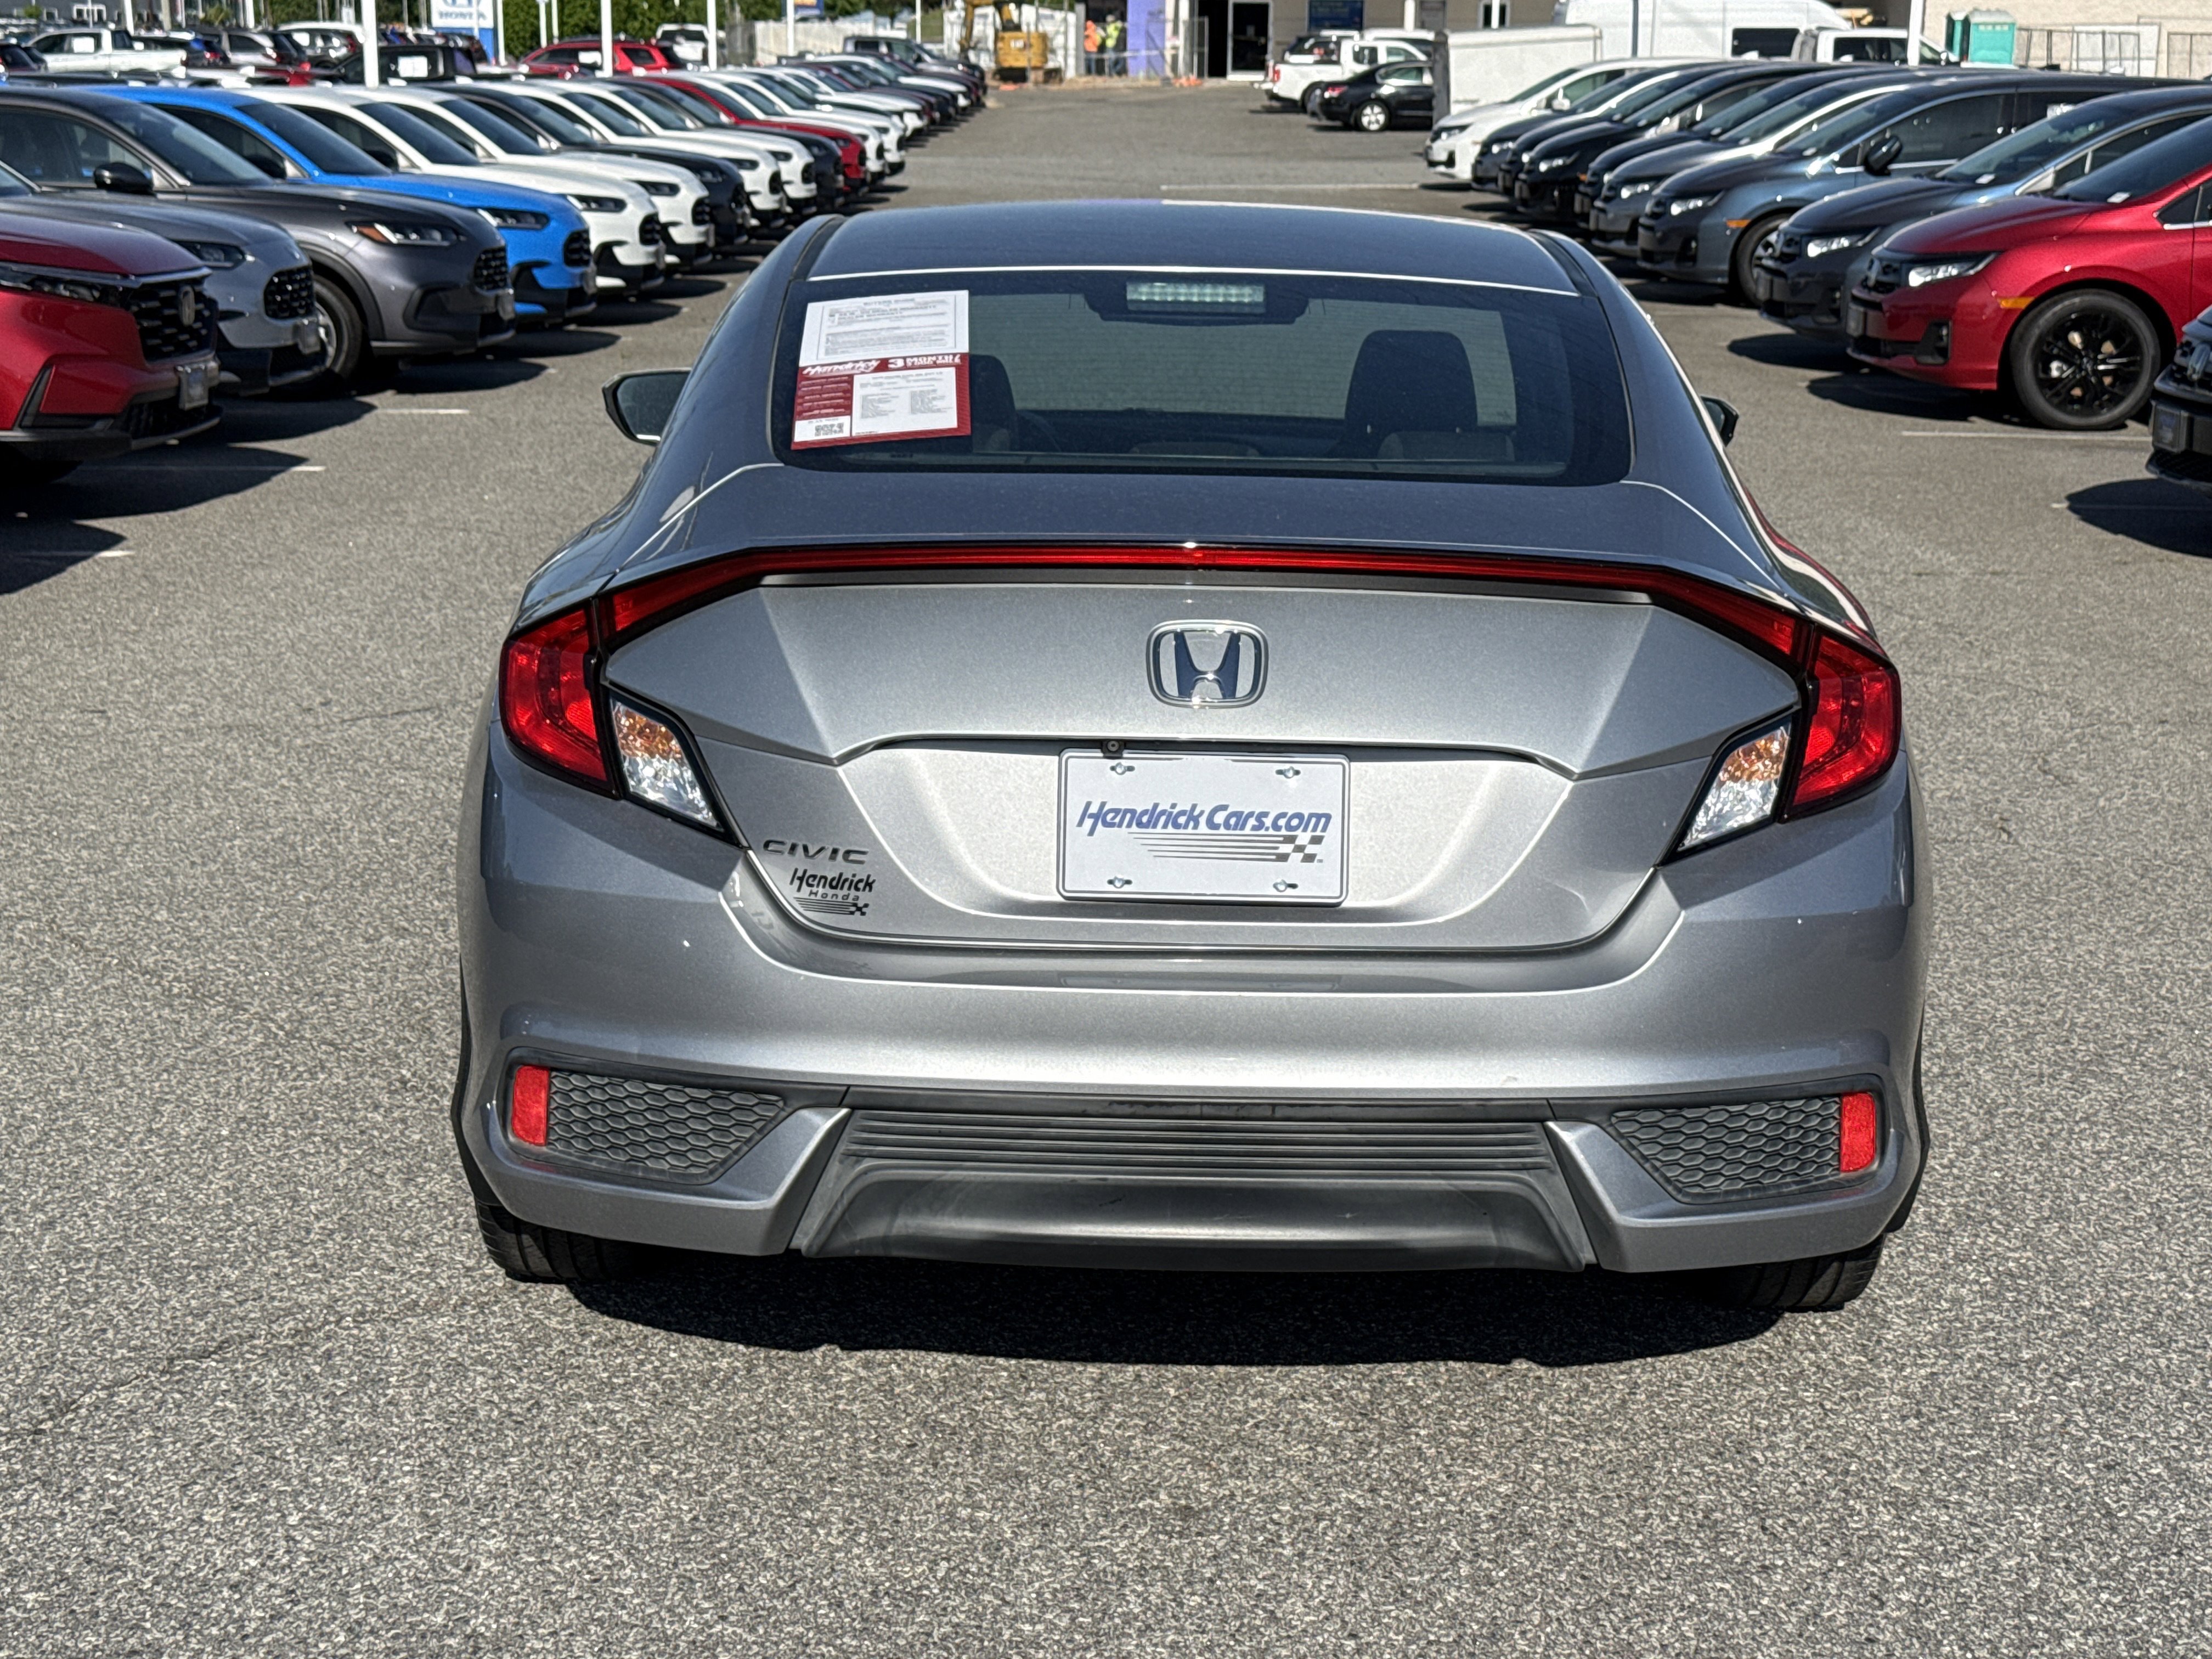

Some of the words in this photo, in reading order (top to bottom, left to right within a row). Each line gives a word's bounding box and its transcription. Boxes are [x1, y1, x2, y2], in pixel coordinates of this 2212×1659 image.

[888, 358, 905, 369] 3
[1076, 801, 1332, 837] HendrickCars.com
[763, 839, 869, 865] CIVIC
[789, 867, 876, 893] Hendrick
[808, 889, 860, 901] Honda
